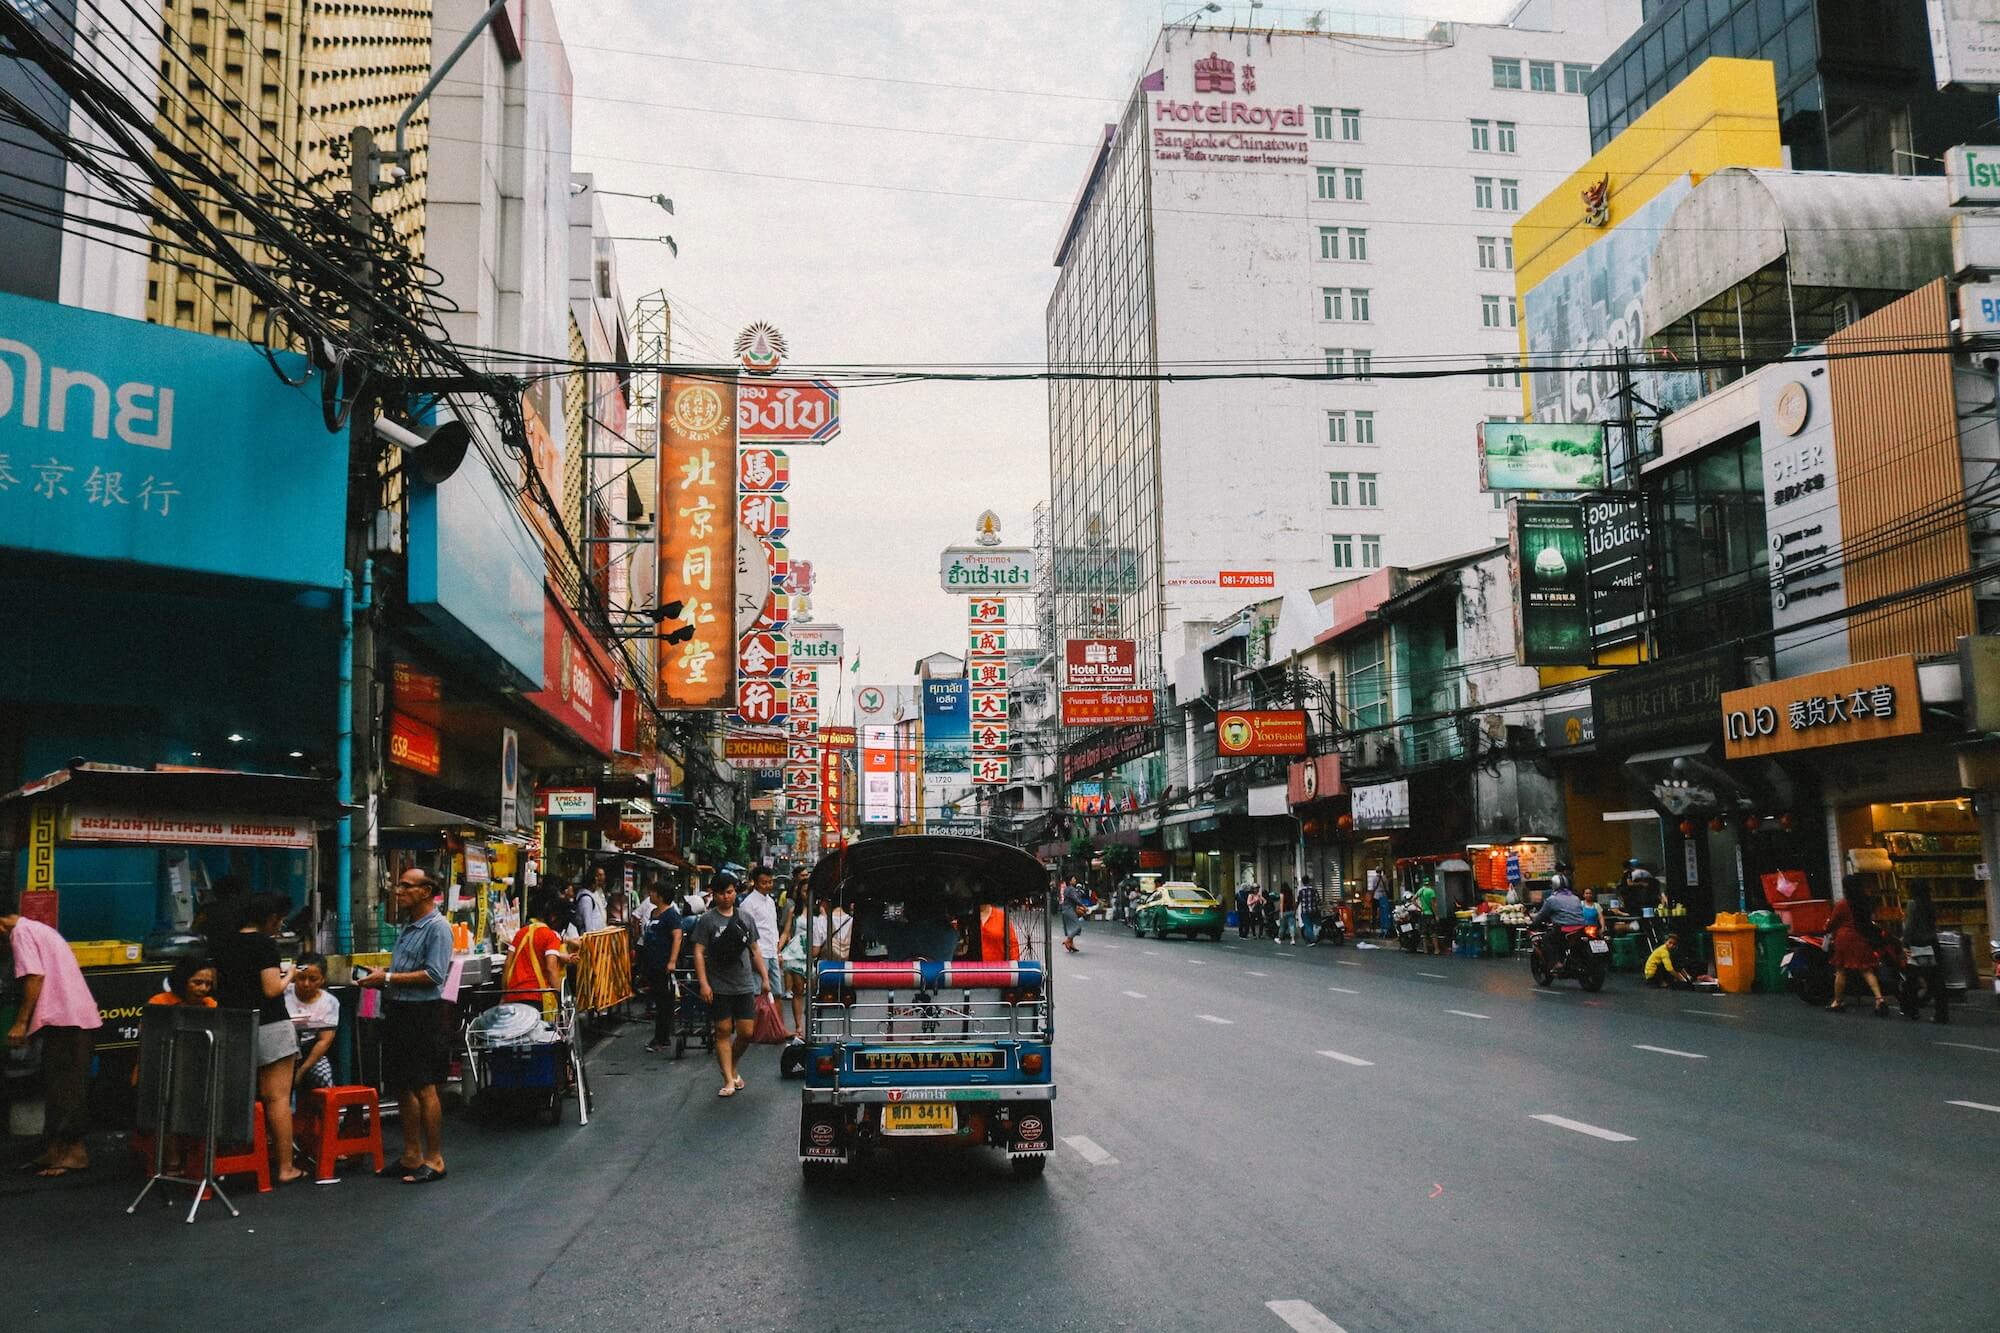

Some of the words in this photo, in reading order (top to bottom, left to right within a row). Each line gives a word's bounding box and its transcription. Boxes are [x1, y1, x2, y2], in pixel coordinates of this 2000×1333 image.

[1156, 100, 1227, 124] Hotel
[1231, 102, 1305, 131] Royal
[1155, 132, 1218, 149] Bangkok
[1226, 134, 1308, 152] Chinatown
[678, 447, 716, 684] 北京同仁堂
[1222, 575, 1273, 585] 081-7708518
[1069, 664, 1098, 674] Hotel
[1101, 664, 1132, 675] Royal
[1788, 685, 1893, 730] 泰货大本营
[391, 734, 408, 757] GSB
[726, 742, 787, 754] EXCHANGE
[866, 1053, 993, 1068] THAILAND
[918, 1105, 950, 1119] 3411
